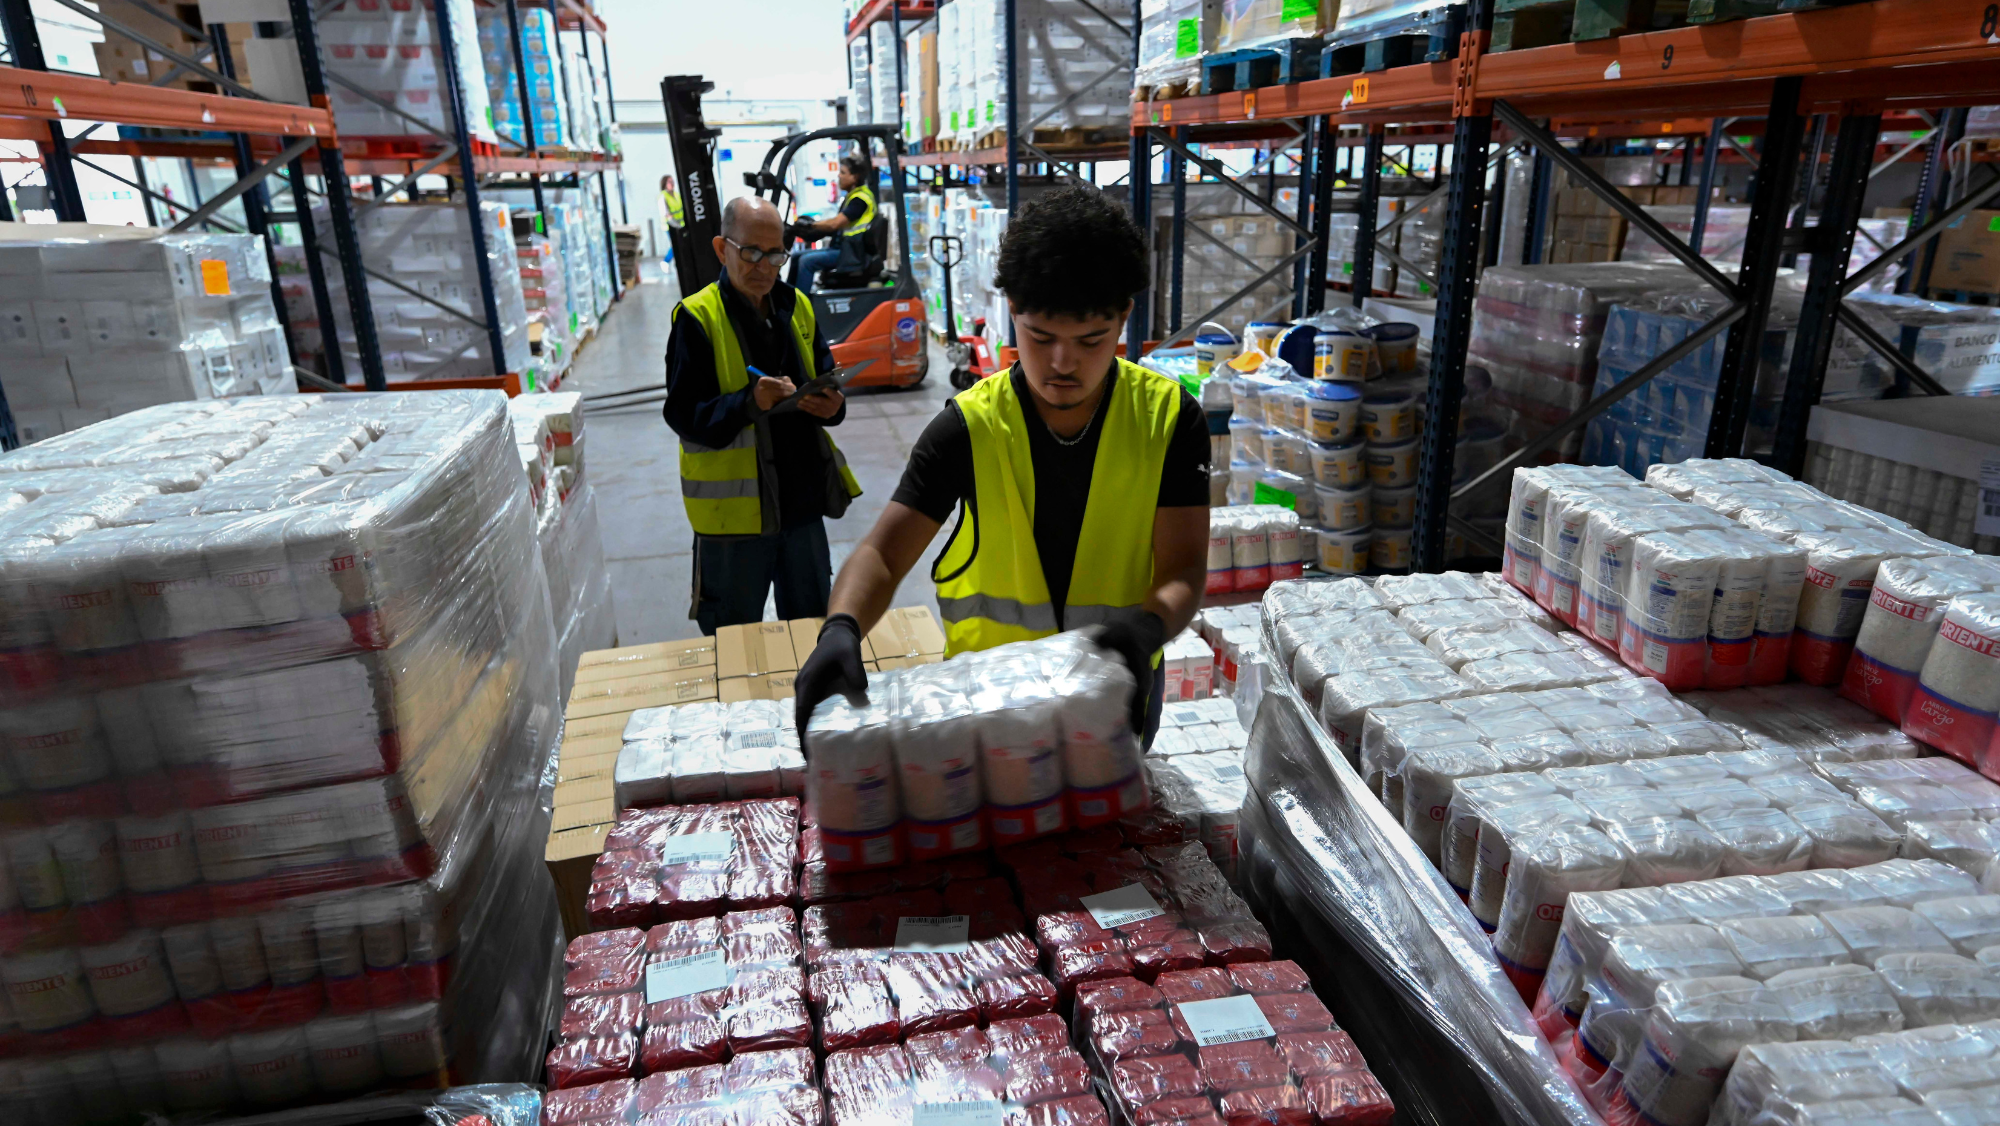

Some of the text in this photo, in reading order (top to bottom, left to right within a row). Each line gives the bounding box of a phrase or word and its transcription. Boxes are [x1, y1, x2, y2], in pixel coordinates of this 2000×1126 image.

[1980, 3, 1998, 38] 8
[1661, 44, 1674, 70] 9
[21, 84, 37, 106] 10
[1356, 84, 1366, 98] 10
[688, 171, 706, 222] TOYOTA
[1954, 333, 1997, 347] BANCO
[1871, 587, 1926, 621] ORIENTE
[1927, 701, 1951, 714] ARROZ
